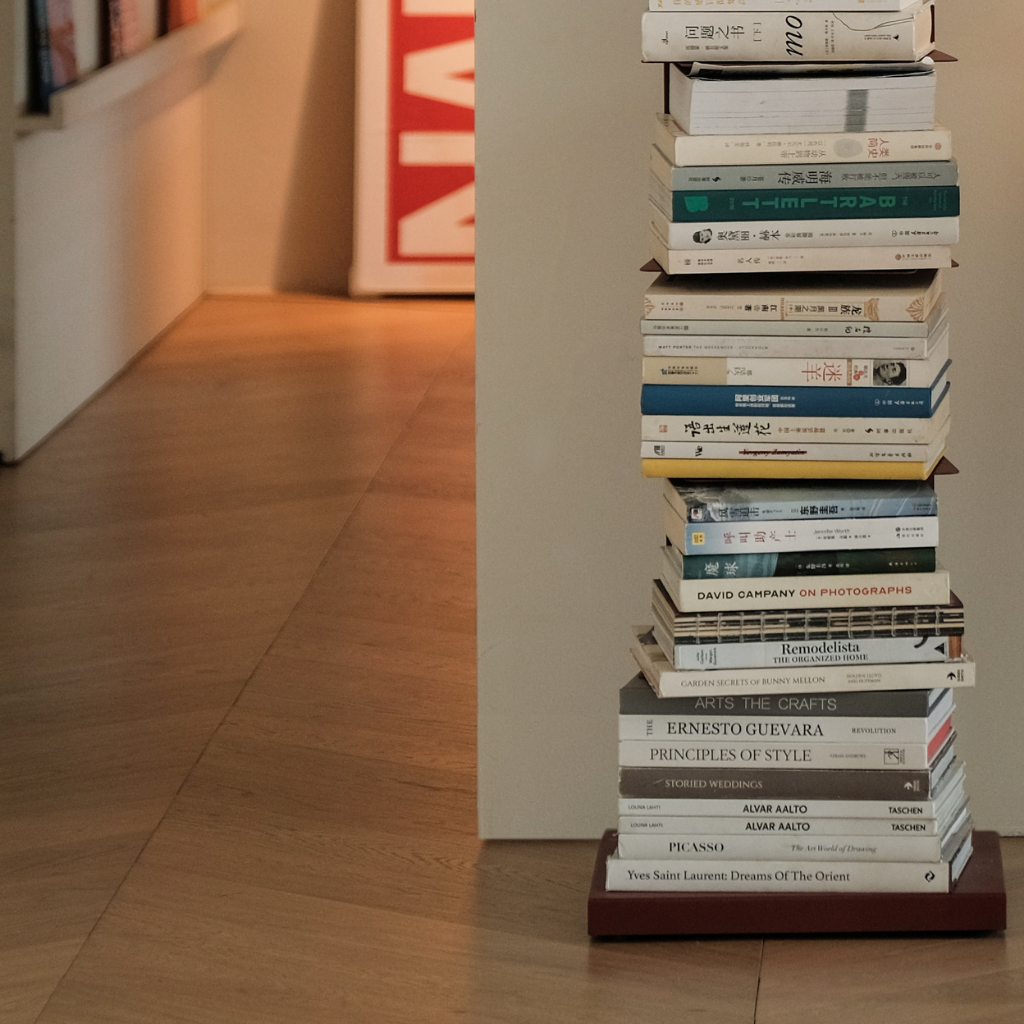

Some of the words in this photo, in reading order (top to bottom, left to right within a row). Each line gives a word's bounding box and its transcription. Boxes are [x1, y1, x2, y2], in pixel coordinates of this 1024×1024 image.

[685, 26, 746, 40] 问题之书
[780, 150, 827, 159] 从动物到上帝
[777, 171, 832, 185] 海明威传
[741, 195, 897, 210] BARTLETT
[717, 230, 781, 242] 奥黛丽·赫本
[737, 257, 761, 265] 名人传
[762, 304, 777, 312] 江南
[794, 305, 825, 313] 黑月之潮
[840, 304, 862, 316] 龙族
[801, 362, 843, 383] 迷羊
[684, 420, 771, 438] 语出生莲花
[718, 507, 759, 518] 风雪追击
[800, 505, 838, 516] 东野圭吾
[723, 530, 797, 545] 呼叫助产士
[704, 561, 739, 576] 魔球
[697, 591, 734, 600] DAVID
[738, 589, 796, 599] CAMPANY
[799, 589, 816, 597] ON
[820, 586, 913, 596] PHOTOGRAPHS
[781, 641, 860, 655] Remodelista
[792, 655, 841, 663] ORGANIZED
[842, 653, 868, 662] HOME
[680, 680, 714, 688] GARDEN
[716, 679, 748, 687] SECRETS
[762, 678, 791, 686] BUNNY
[793, 677, 826, 685] MELLON
[695, 697, 734, 709] ARTS
[742, 698, 771, 710] THE
[778, 698, 837, 711] CRAFTS
[667, 722, 742, 735] ERNESTO
[746, 723, 824, 737] GUEVARA
[851, 727, 897, 735] REVOLUTION
[650, 748, 737, 761] PRINCIPLES
[740, 749, 762, 761] OF
[765, 749, 812, 762] STYLE
[665, 779, 707, 788] STORIED
[709, 780, 763, 789] WEDDINGS
[743, 805, 773, 814] ALVAR
[775, 805, 807, 814] AALTO
[745, 822, 775, 831] ALVAR
[778, 823, 810, 831] AALTO
[669, 842, 725, 853] PICASSO
[839, 845, 846, 854] of
[847, 845, 877, 854] Drawing
[628, 870, 651, 880] Yves
[653, 870, 681, 880] Saint
[684, 870, 728, 881] Laurent:
[731, 871, 772, 881] Dreams
[775, 871, 791, 881] Of
[792, 871, 813, 881] The
[815, 871, 850, 882] Orient
